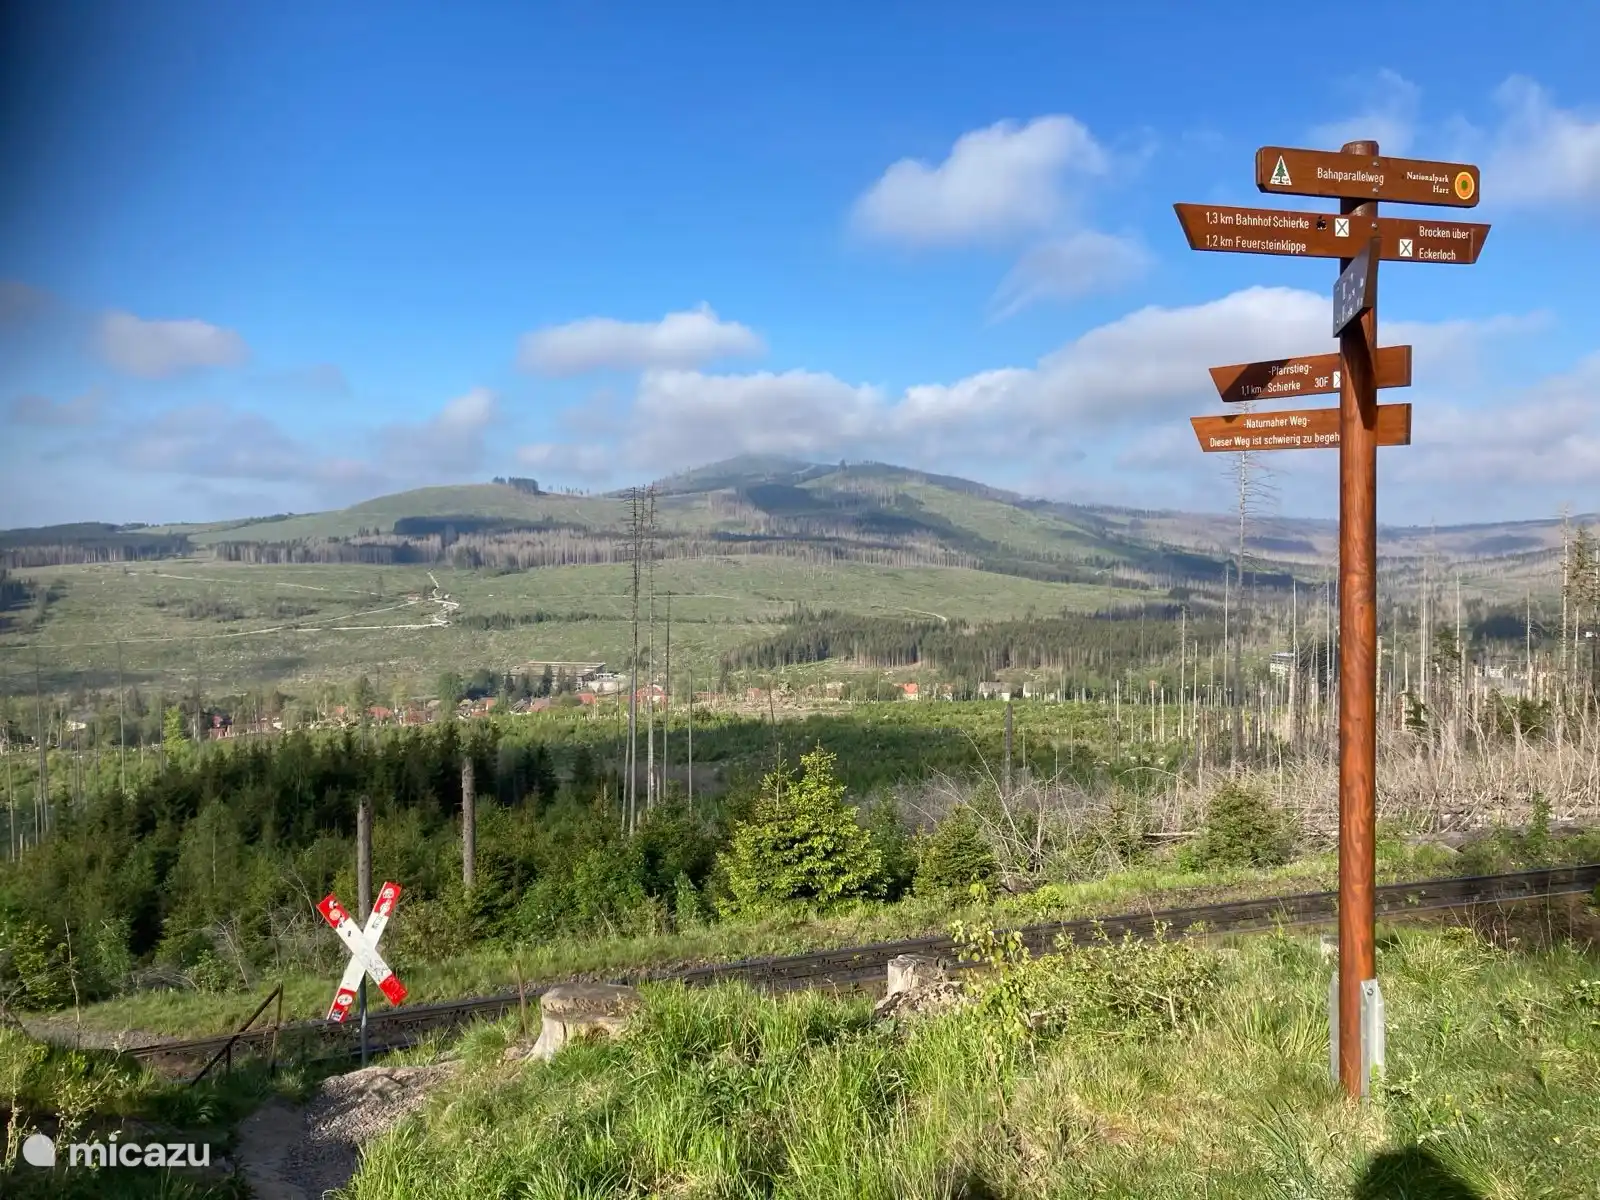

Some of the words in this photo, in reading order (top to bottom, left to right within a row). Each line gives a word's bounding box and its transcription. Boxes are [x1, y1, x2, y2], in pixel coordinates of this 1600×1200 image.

[1317, 167, 1384, 186] Bahnparallelweg
[1406, 171, 1449, 183] Nationalpark
[1432, 184, 1449, 194] Harz
[1220, 213, 1234, 225] km
[1236, 214, 1272, 227] Bahnhof
[1273, 217, 1310, 230] Schierke
[1419, 225, 1451, 238] Brocken
[1452, 228, 1469, 239] über
[1220, 236, 1234, 247] km
[1236, 236, 1307, 254] Feuersteinklippe
[1419, 247, 1456, 260] Eckerloch
[1250, 386, 1262, 395] km
[1267, 382, 1301, 393] Schierke
[1314, 376, 1329, 388] 30F
[1209, 437, 1233, 447] Dieser
[1234, 437, 1250, 447] Weg
[1252, 434, 1262, 445] ist
[1263, 435, 1301, 445] schwierig
[1302, 435, 1313, 443] zu
